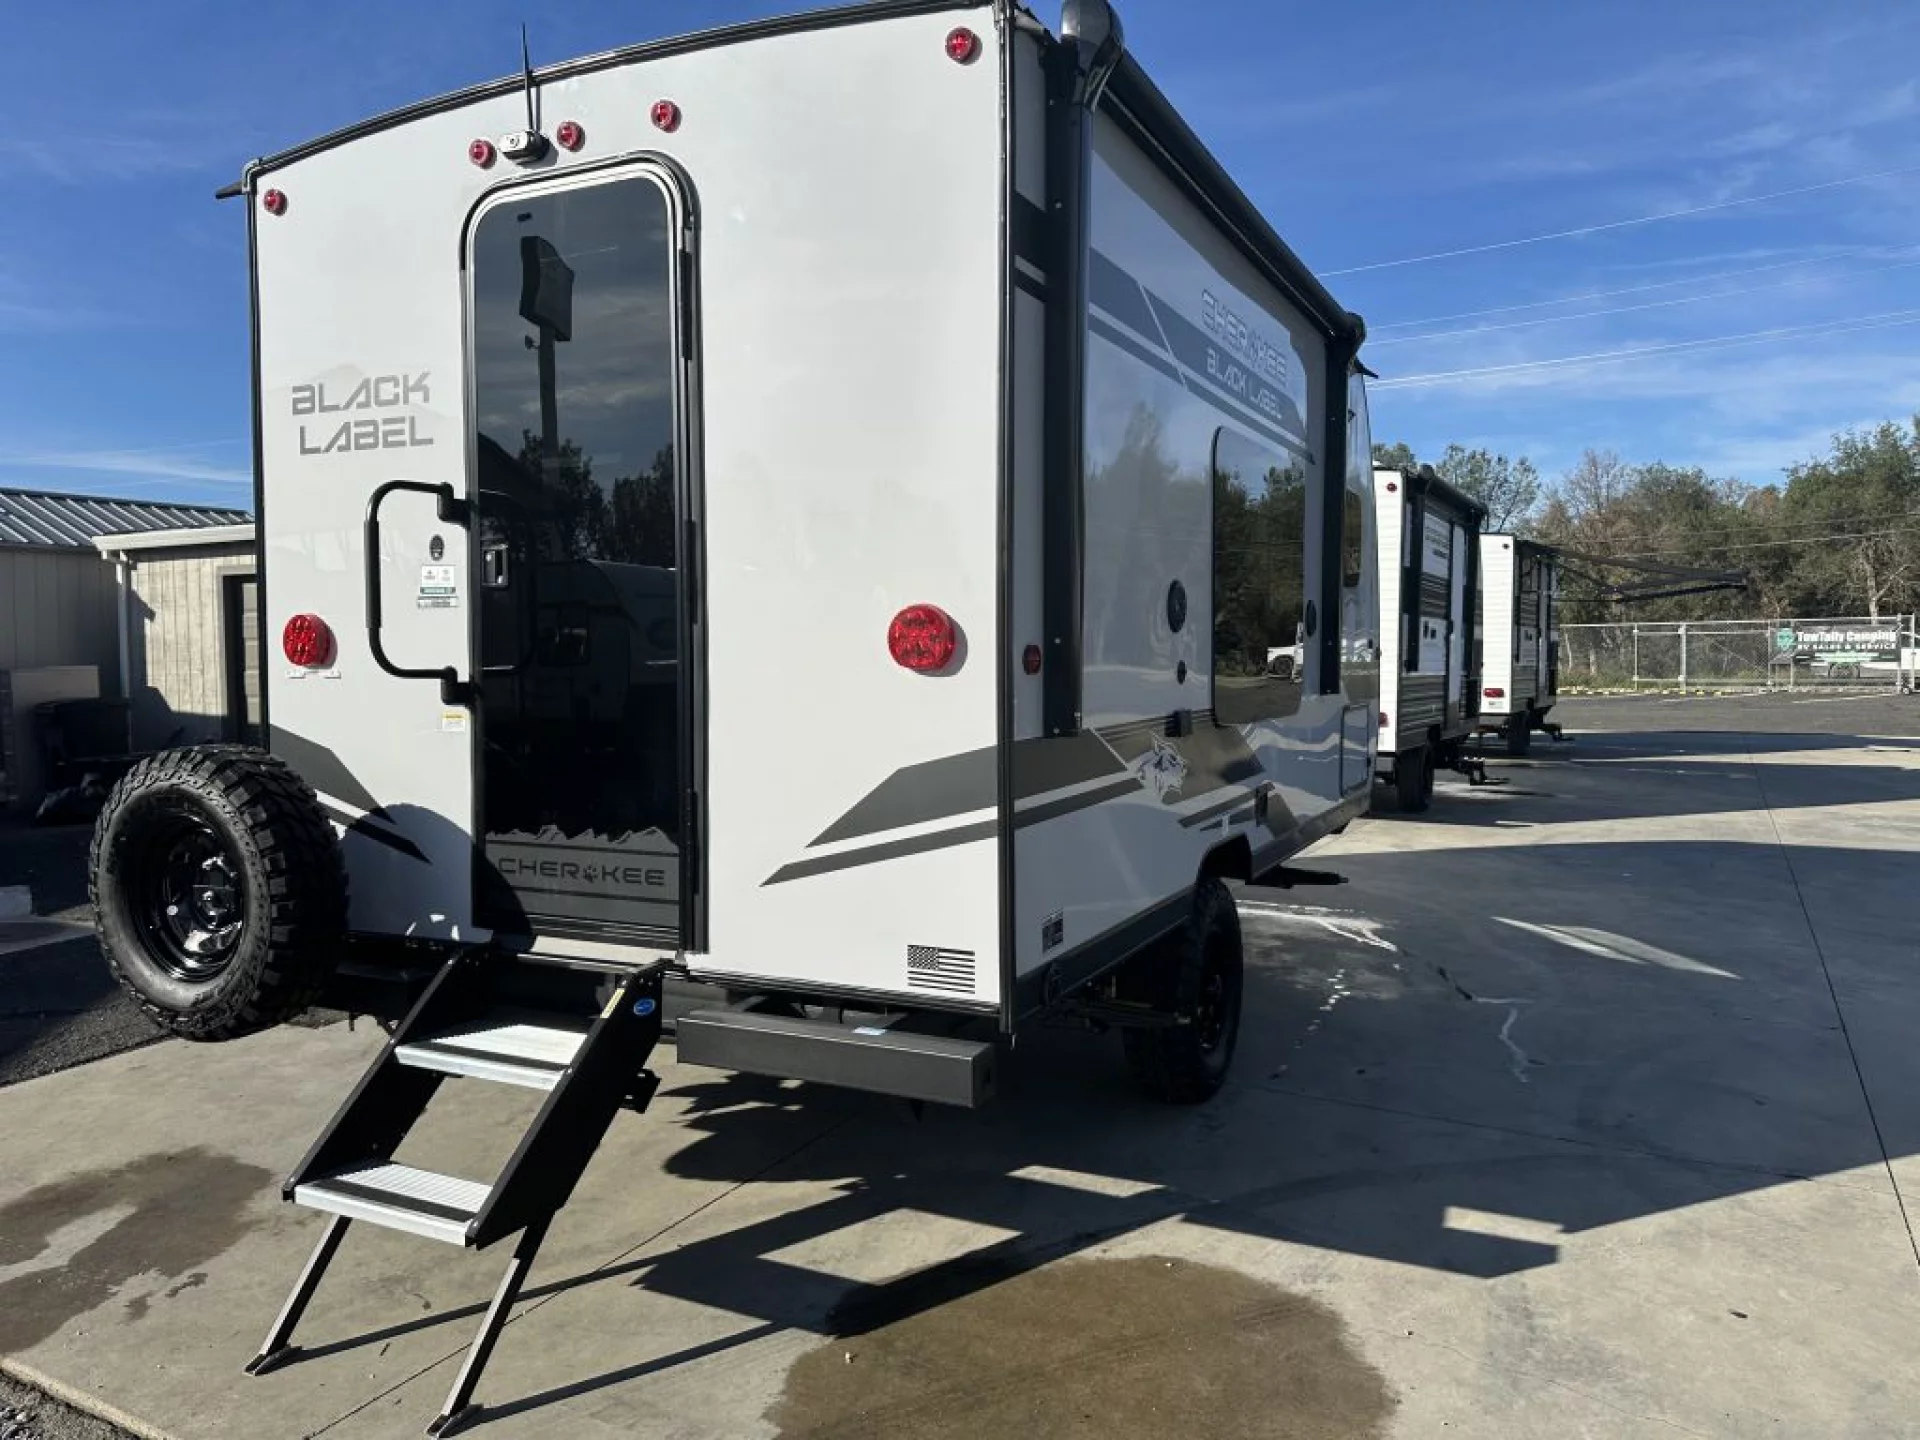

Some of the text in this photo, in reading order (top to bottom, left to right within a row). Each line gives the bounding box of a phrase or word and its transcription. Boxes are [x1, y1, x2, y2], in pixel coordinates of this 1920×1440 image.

[292, 371, 430, 415] BLACK
[1207, 346, 1283, 419] BLACK LABEL
[299, 415, 434, 456] LABEL
